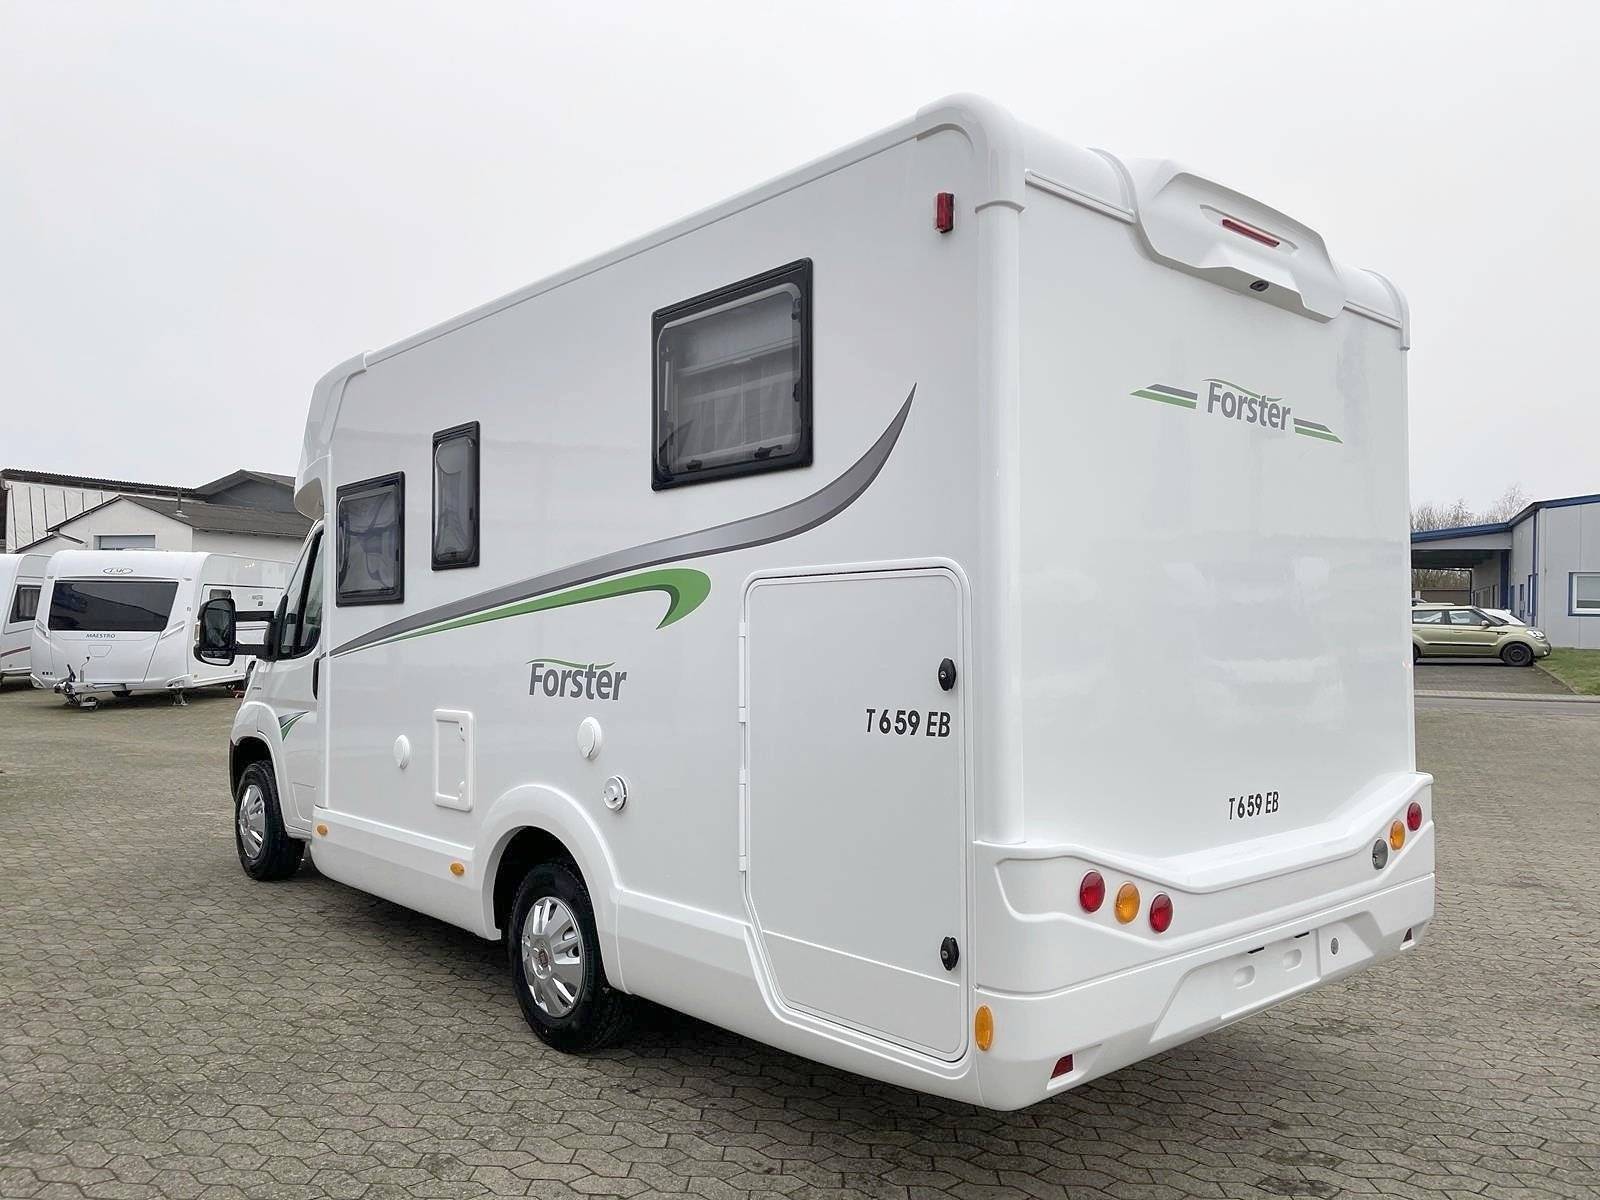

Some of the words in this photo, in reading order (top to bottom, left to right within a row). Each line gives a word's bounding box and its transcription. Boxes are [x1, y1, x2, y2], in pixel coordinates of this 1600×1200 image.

[1206, 381, 1291, 430] Forster
[528, 662, 627, 701] Forster
[926, 711, 951, 738] EB
[1265, 791, 1279, 813] EB
